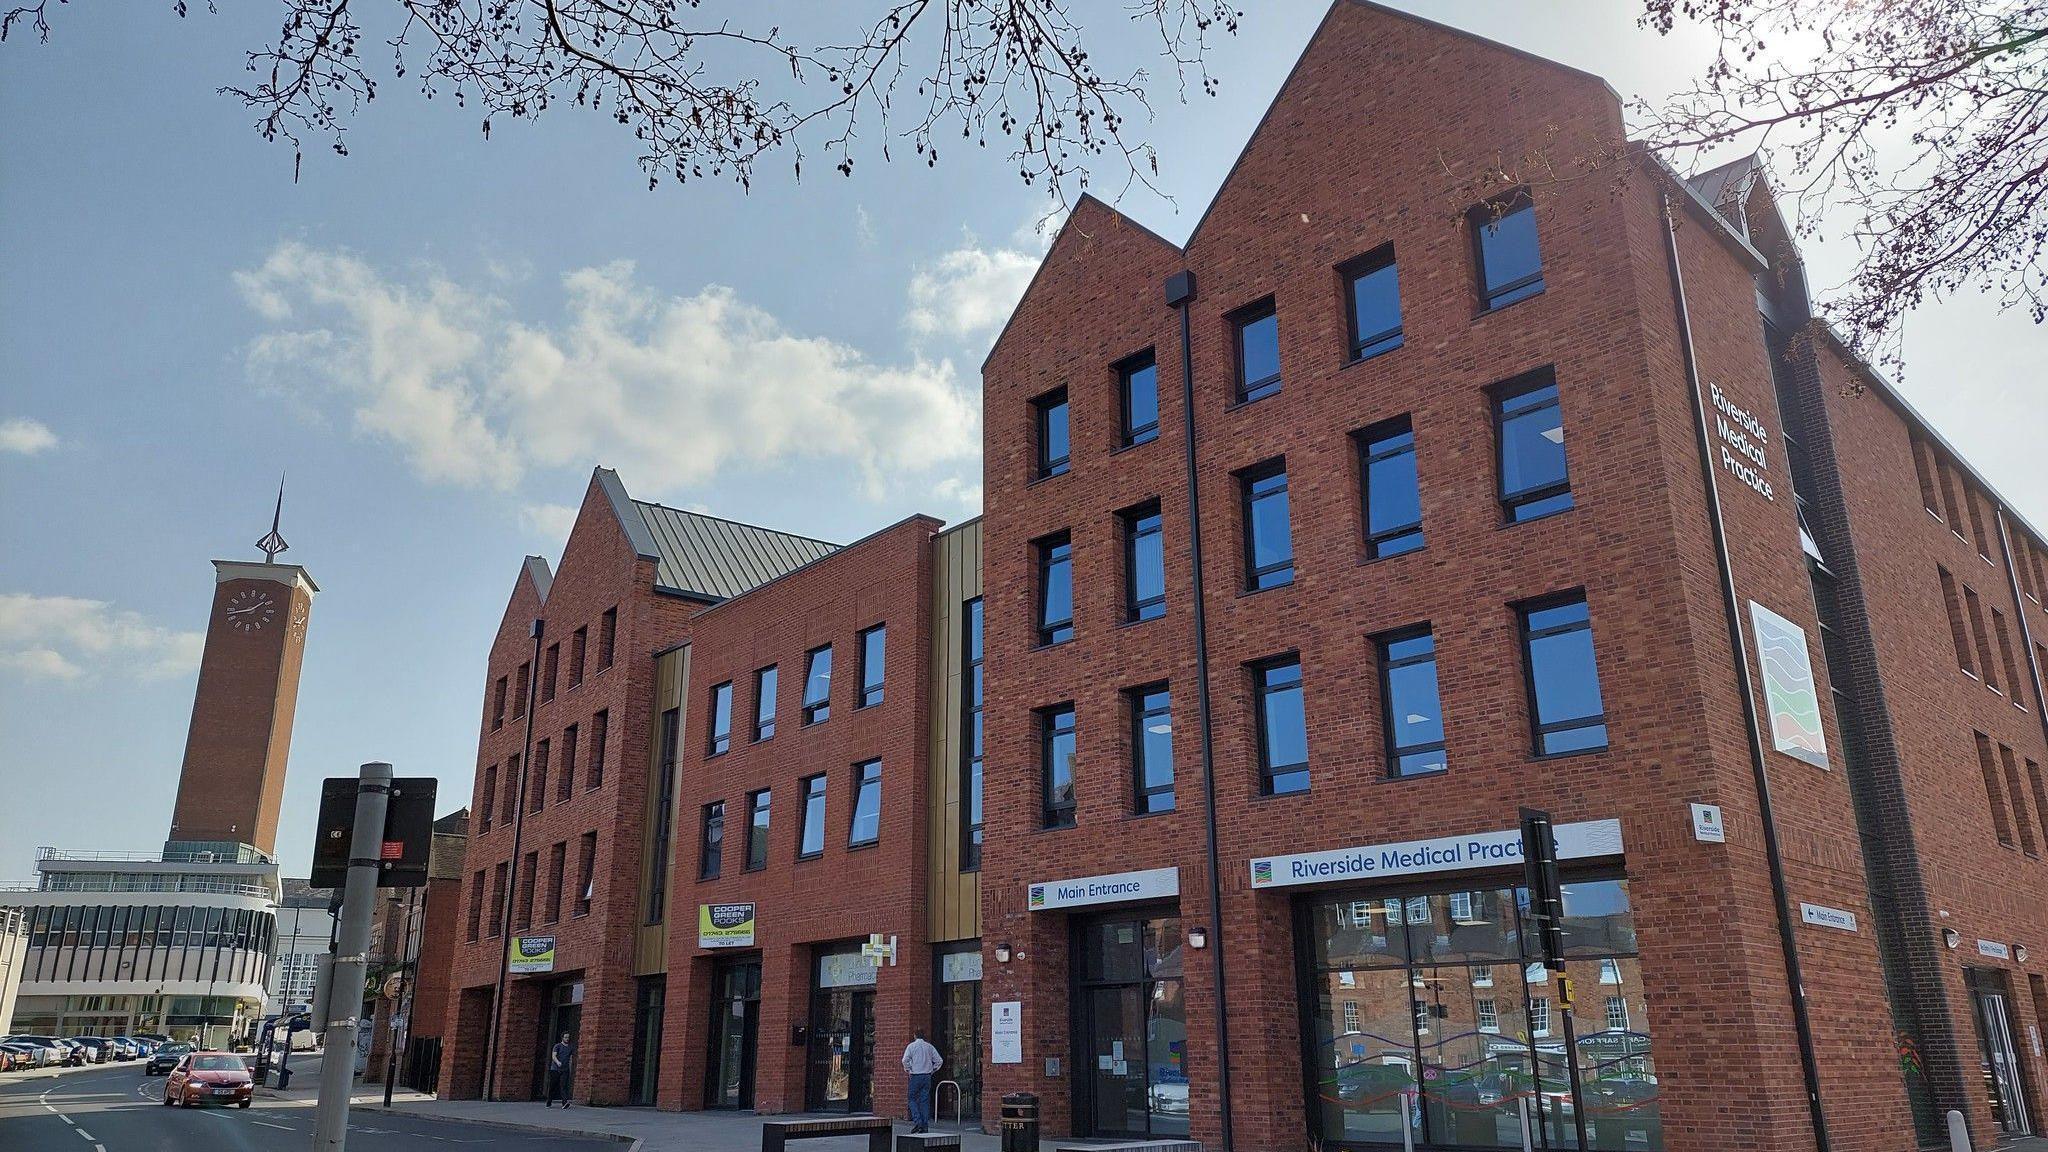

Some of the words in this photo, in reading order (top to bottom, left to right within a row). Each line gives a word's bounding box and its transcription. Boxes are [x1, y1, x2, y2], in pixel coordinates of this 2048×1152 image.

[1710, 381, 1768, 444] Riverside
[1716, 413, 1767, 470] Medical
[1721, 445, 1774, 501] Practice
[1292, 854, 1375, 878] Riverside
[1381, 843, 1462, 869] Medical
[1468, 838, 1559, 861] Practe
[1057, 885, 1086, 901] Main
[1089, 881, 1141, 897] Entrance
